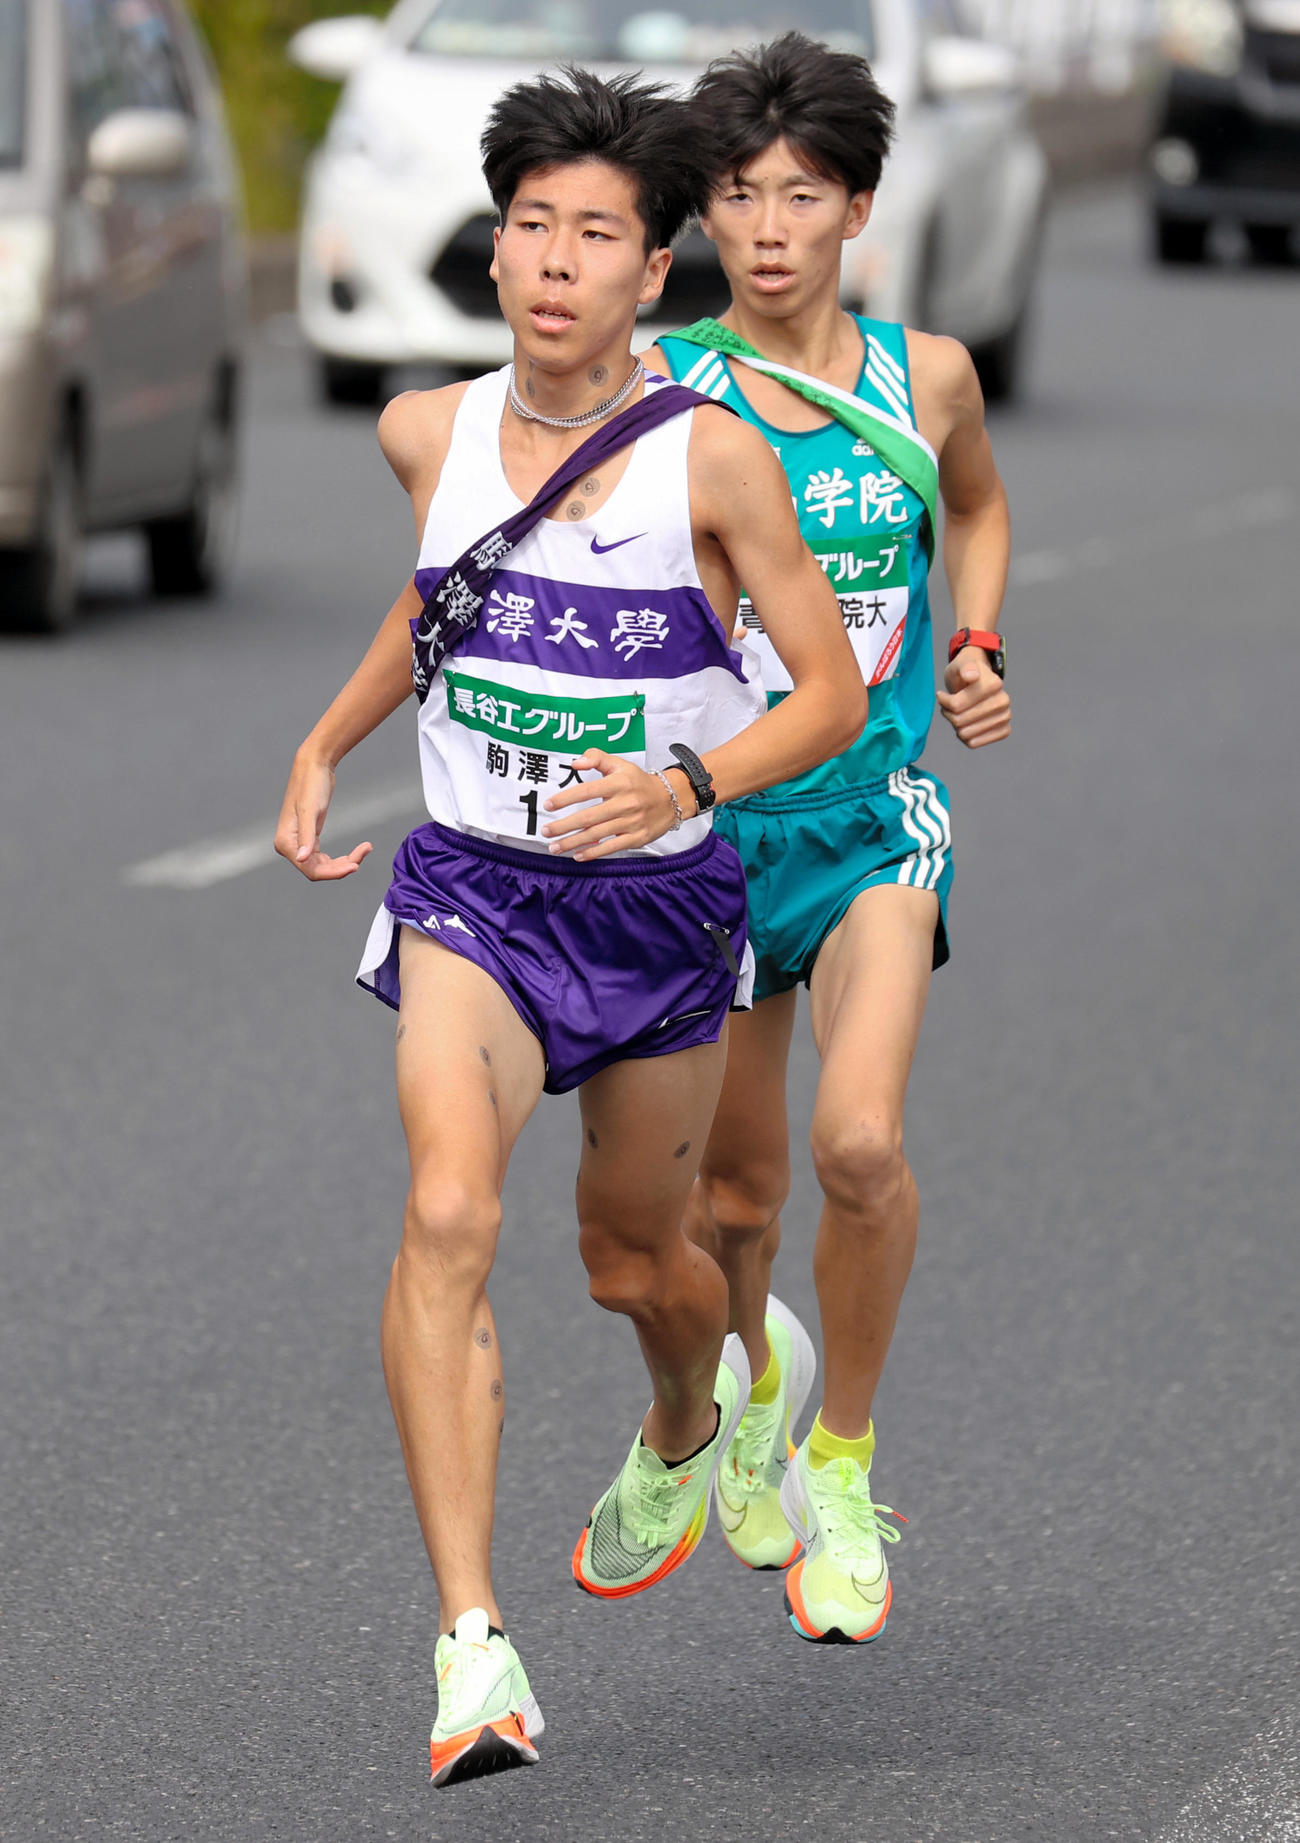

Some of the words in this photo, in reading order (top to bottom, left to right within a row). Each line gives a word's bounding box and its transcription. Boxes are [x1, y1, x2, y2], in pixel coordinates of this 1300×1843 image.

[792, 467, 909, 529] 学院
[454, 687, 637, 742] 長谷工グループ
[486, 741, 585, 789] 駒澤大
[519, 789, 539, 836] 1
